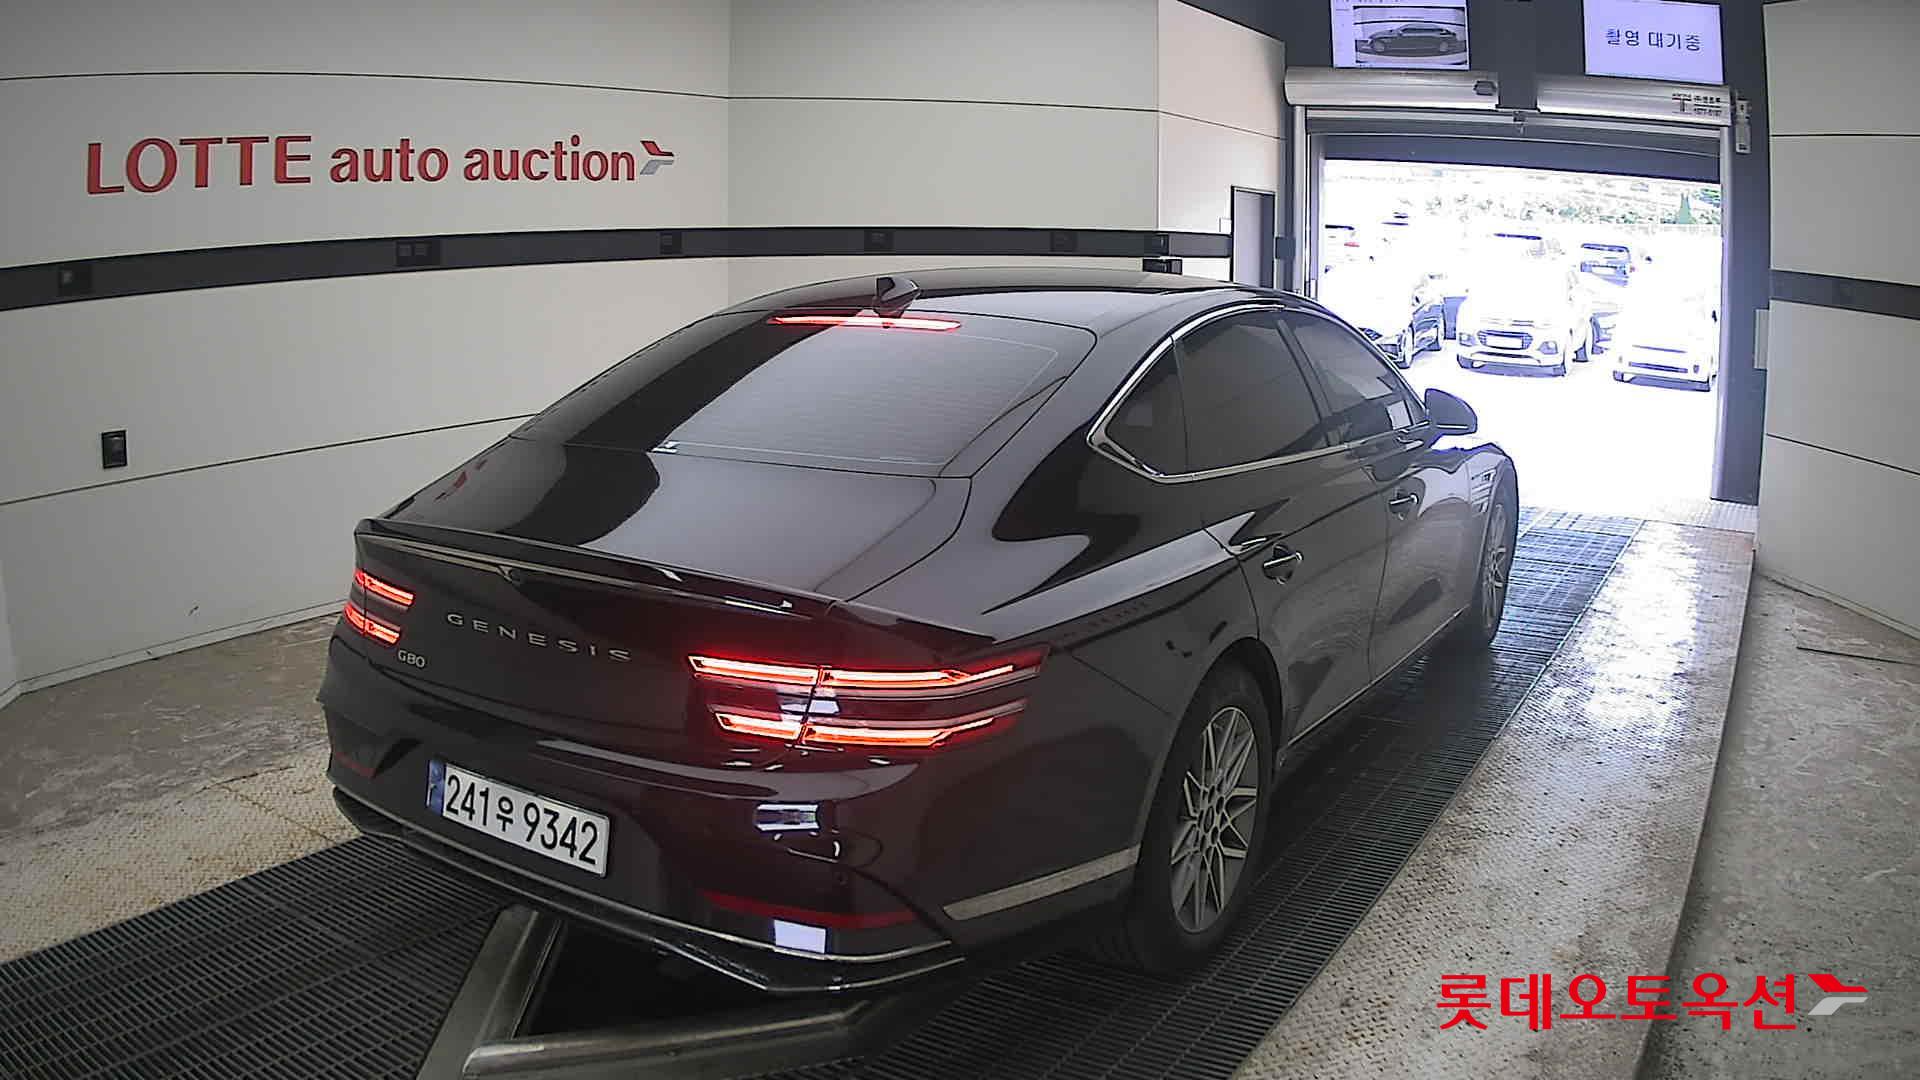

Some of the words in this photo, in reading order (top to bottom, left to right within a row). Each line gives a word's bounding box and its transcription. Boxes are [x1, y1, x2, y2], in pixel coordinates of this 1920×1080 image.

[1648, 31, 1701, 51] 대기중
[86, 135, 312, 194] LOTTE
[329, 137, 449, 184] auto
[463, 134, 635, 182] auction
[447, 613, 631, 663] GENESIS
[397, 649, 426, 669] G80
